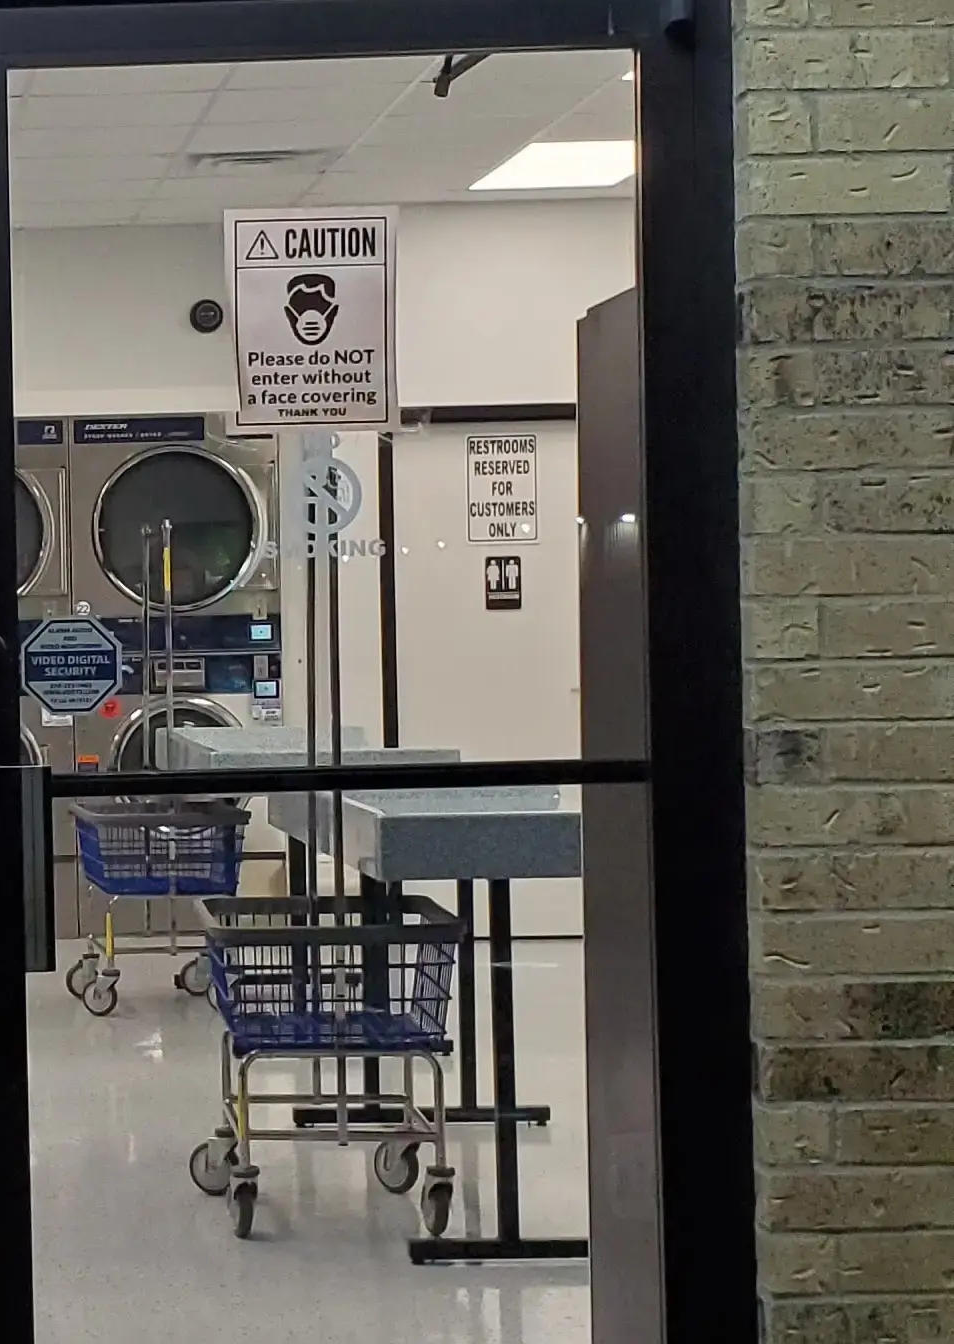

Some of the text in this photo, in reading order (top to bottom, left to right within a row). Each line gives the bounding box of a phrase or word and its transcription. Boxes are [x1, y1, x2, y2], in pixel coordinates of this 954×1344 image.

[284, 227, 376, 259] CAUTION
[247, 349, 375, 367] Please do NOT
[251, 369, 372, 386] enter without
[247, 387, 377, 405] a face covering
[278, 407, 347, 418] THANK YOU
[469, 438, 535, 455] RESTROOMS
[474, 459, 530, 476] RESERVED
[491, 481, 513, 497] FOR
[470, 501, 535, 517] CUSTOMERS
[489, 522, 517, 537] ONLY
[265, 538, 387, 559] SOKING
[31, 655, 110, 665] VIDEO DIGITAL
[44, 666, 97, 676] SECURITY
